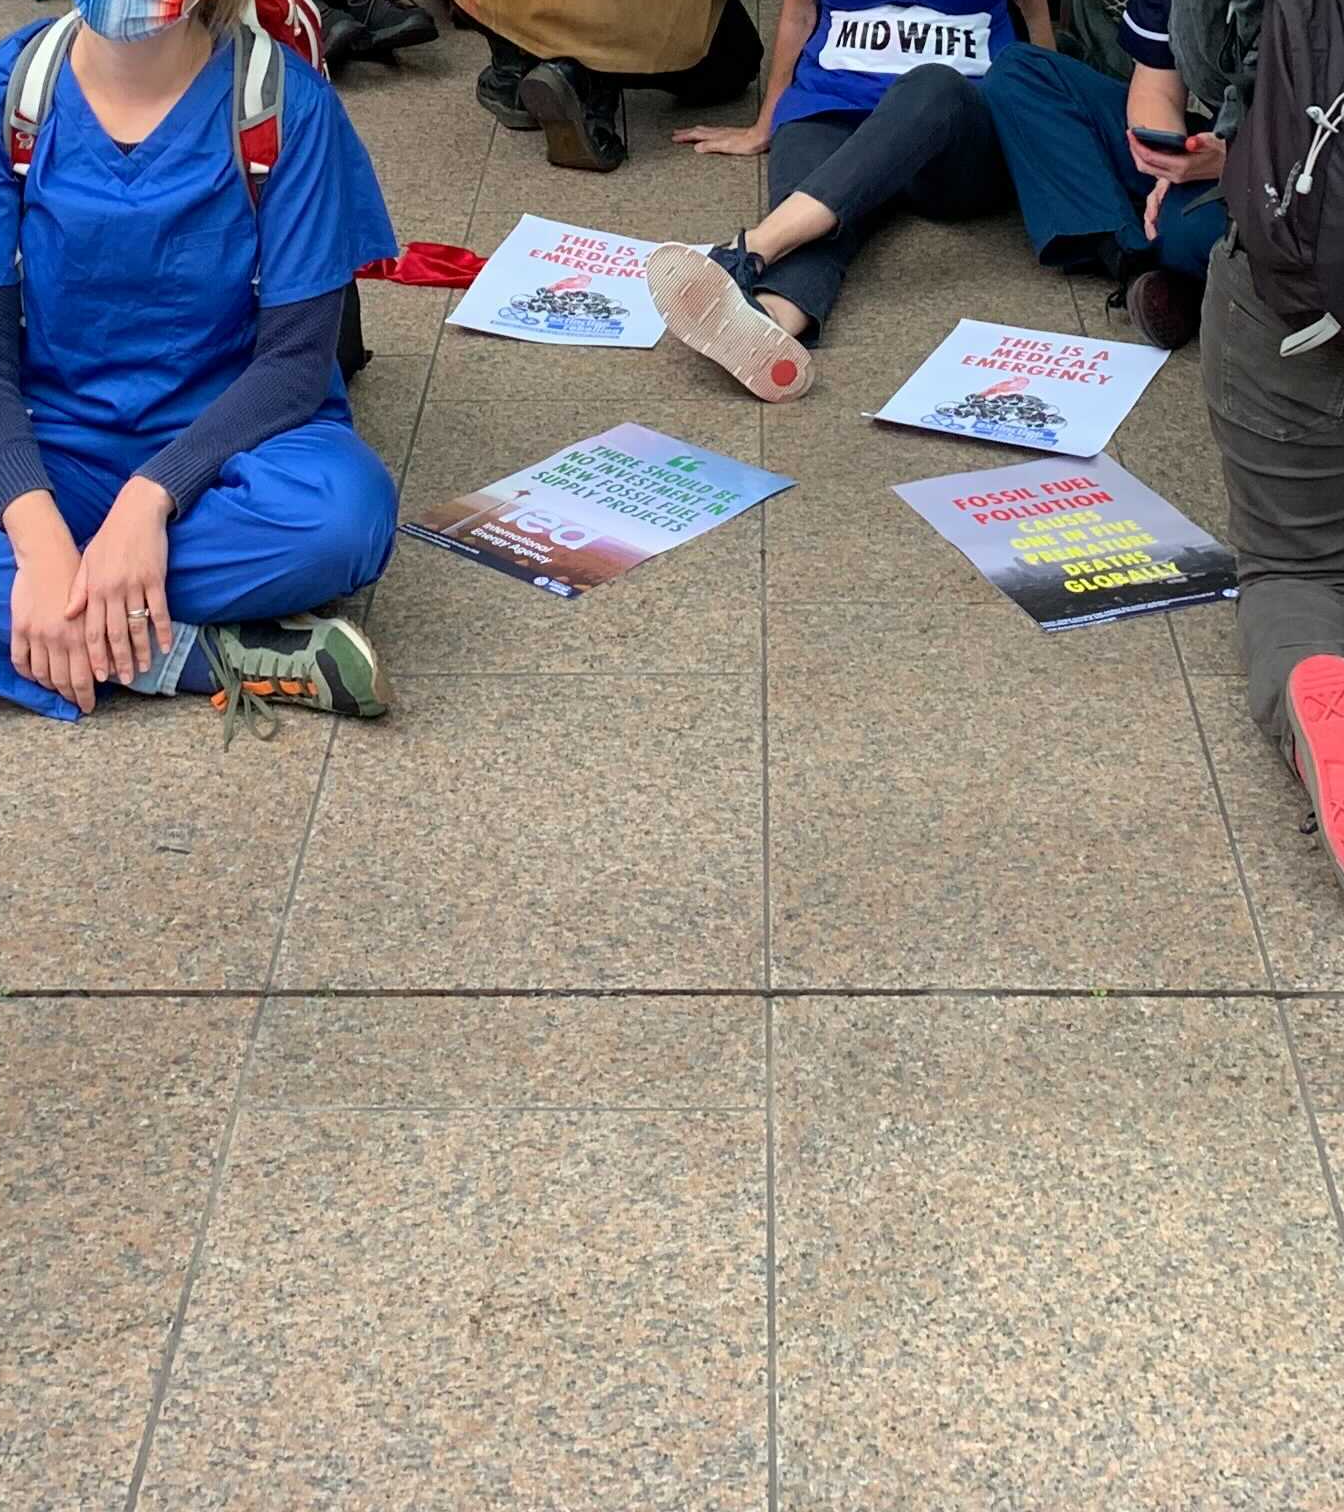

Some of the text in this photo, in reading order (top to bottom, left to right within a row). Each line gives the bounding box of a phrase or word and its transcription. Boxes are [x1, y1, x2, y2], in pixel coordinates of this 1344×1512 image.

[561, 234, 637, 256] THIS IS
[529, 249, 647, 278] EMERGENC
[991, 348, 1100, 371] MEDICAL
[1000, 337, 1110, 360] THIS IS A
[961, 356, 1113, 385] EMERGENCY
[564, 450, 729, 516] NO INVESTMENT IN
[590, 445, 742, 503] THERE SHOULD BE
[531, 471, 689, 533] SUPPLY PROJECTS
[554, 463, 704, 523] NEW FOSSIL FUEL
[953, 477, 1100, 512] FOSSIL FUEL
[973, 491, 1115, 525] POLLUTION
[1010, 519, 1143, 550] ONE IN FIVE
[1017, 510, 1103, 533] CAUSES
[470, 530, 512, 549] Energy
[511, 546, 552, 565] Agency
[483, 522, 554, 553] International
[1023, 533, 1159, 566] PREMATURE
[1061, 551, 1153, 577] DEATHS
[1064, 562, 1183, 594] GLOBALLY
